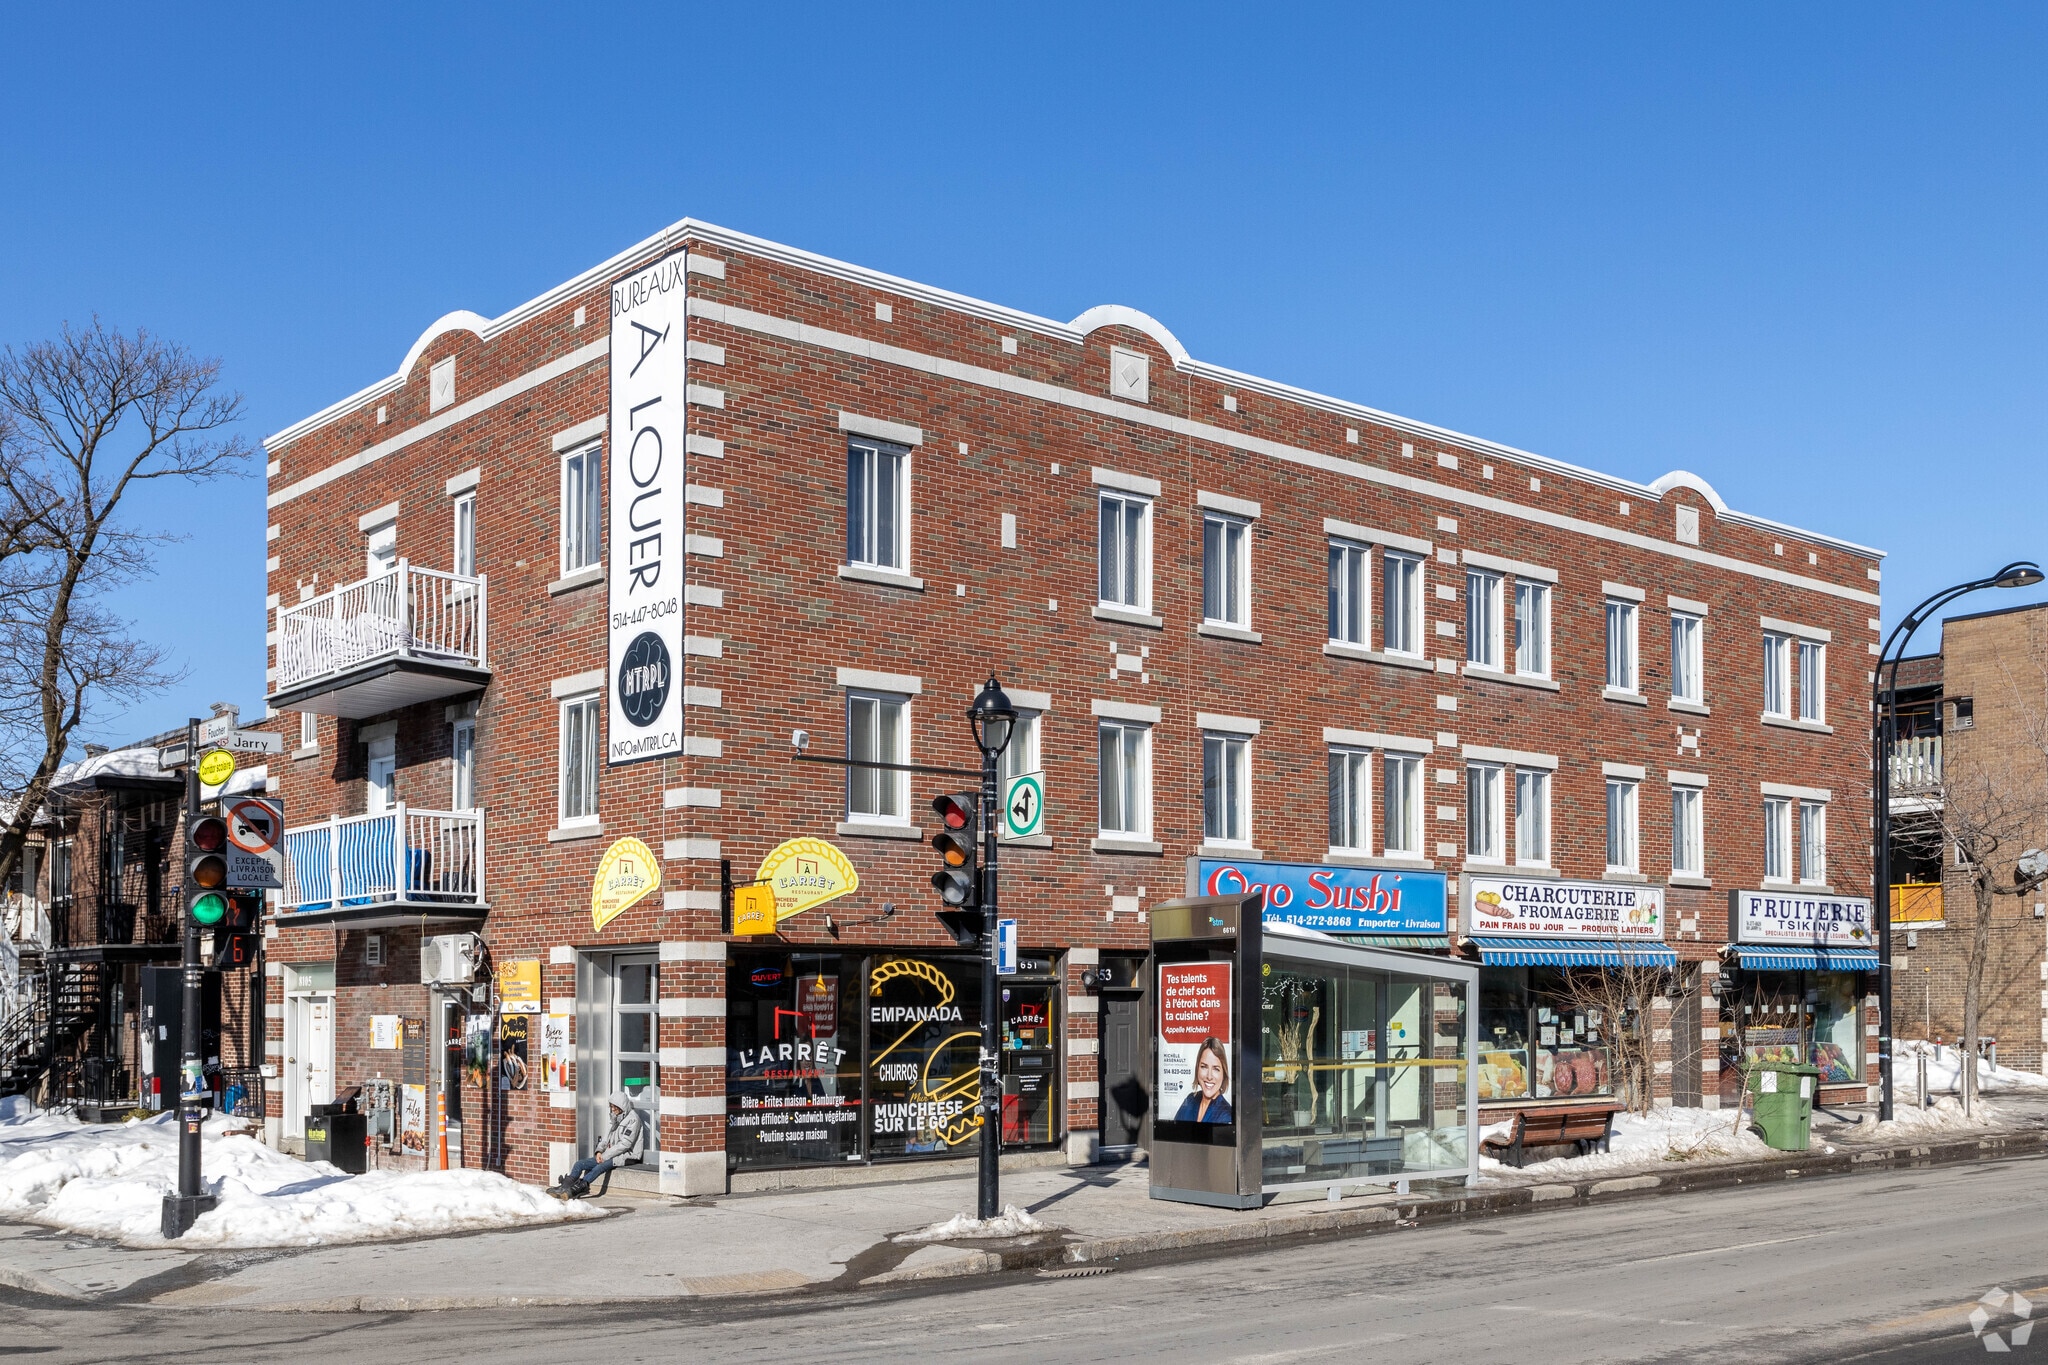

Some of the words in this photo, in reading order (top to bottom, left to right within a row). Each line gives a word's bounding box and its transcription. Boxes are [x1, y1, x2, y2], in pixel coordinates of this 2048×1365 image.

[614, 258, 683, 318] BUREAUX
[630, 320, 670, 378] À
[630, 396, 662, 596] LOUER
[613, 598, 678, 630] 514-447-8048
[626, 661, 665, 696] MTRPL
[208, 726, 226, 739] Foucher
[234, 737, 268, 751] Jarry
[612, 732, 678, 758] INFO@MTRPL.CA
[804, 863, 810, 874] À
[780, 875, 835, 890] L'ARRÊT
[1305, 872, 1403, 915] Sushi
[1502, 884, 1636, 907] CHARCUTERIE
[737, 911, 765, 924] L'ARRÊT
[1519, 905, 1619, 921] FROMAGERIE
[1750, 897, 1865, 923] FRUITERIE
[1286, 913, 1352, 927] 514-272-8868
[1358, 917, 1400, 929] Emporter
[1405, 919, 1441, 929] Livraison
[1480, 921, 1499, 929] PAIN
[1502, 922, 1527, 930] FRAIS
[1581, 924, 1618, 933] PRODUITS
[1777, 920, 1840, 932] TSIKINIS
[233, 937, 243, 962] 6
[299, 976, 312, 986] 8105
[752, 974, 782, 982] OUVERT
[1100, 969, 1112, 981] 53
[1166, 974, 1179, 984] Tes
[1181, 973, 1207, 983] talents
[1166, 986, 1176, 996] de
[1178, 986, 1195, 996] chef
[1196, 986, 1215, 995] sont
[1166, 998, 1171, 1008] à
[1172, 998, 1198, 1008] l'étroit
[1200, 998, 1220, 1007] dans
[870, 1006, 963, 1022] EMPANADA
[1011, 1015, 1044, 1025] L'ARRÊT
[1165, 1012, 1174, 1021] ta
[502, 1024, 527, 1040] Churros
[546, 1024, 563, 1039] Bière
[445, 1038, 462, 1047] L'ARRÊ
[740, 1041, 847, 1069] L'ARRÊT
[763, 1067, 825, 1079] RESTAURANT
[880, 1063, 918, 1081] CHURROS
[742, 1096, 759, 1108] Bière
[764, 1095, 782, 1107] Frites
[784, 1095, 807, 1106] maison
[812, 1094, 846, 1108] Hamburger
[874, 1100, 963, 1119] MUNCHEESE
[729, 1113, 759, 1127] Sandwich
[761, 1111, 788, 1125] éffiloché
[794, 1110, 823, 1124] Sandwich
[825, 1110, 856, 1124] végétarien
[874, 1117, 904, 1133] SUR
[908, 1116, 925, 1131] LE
[929, 1115, 948, 1130] GO
[760, 1130, 784, 1142] Poutine
[785, 1131, 804, 1141] sauce
[806, 1128, 828, 1140] maison
